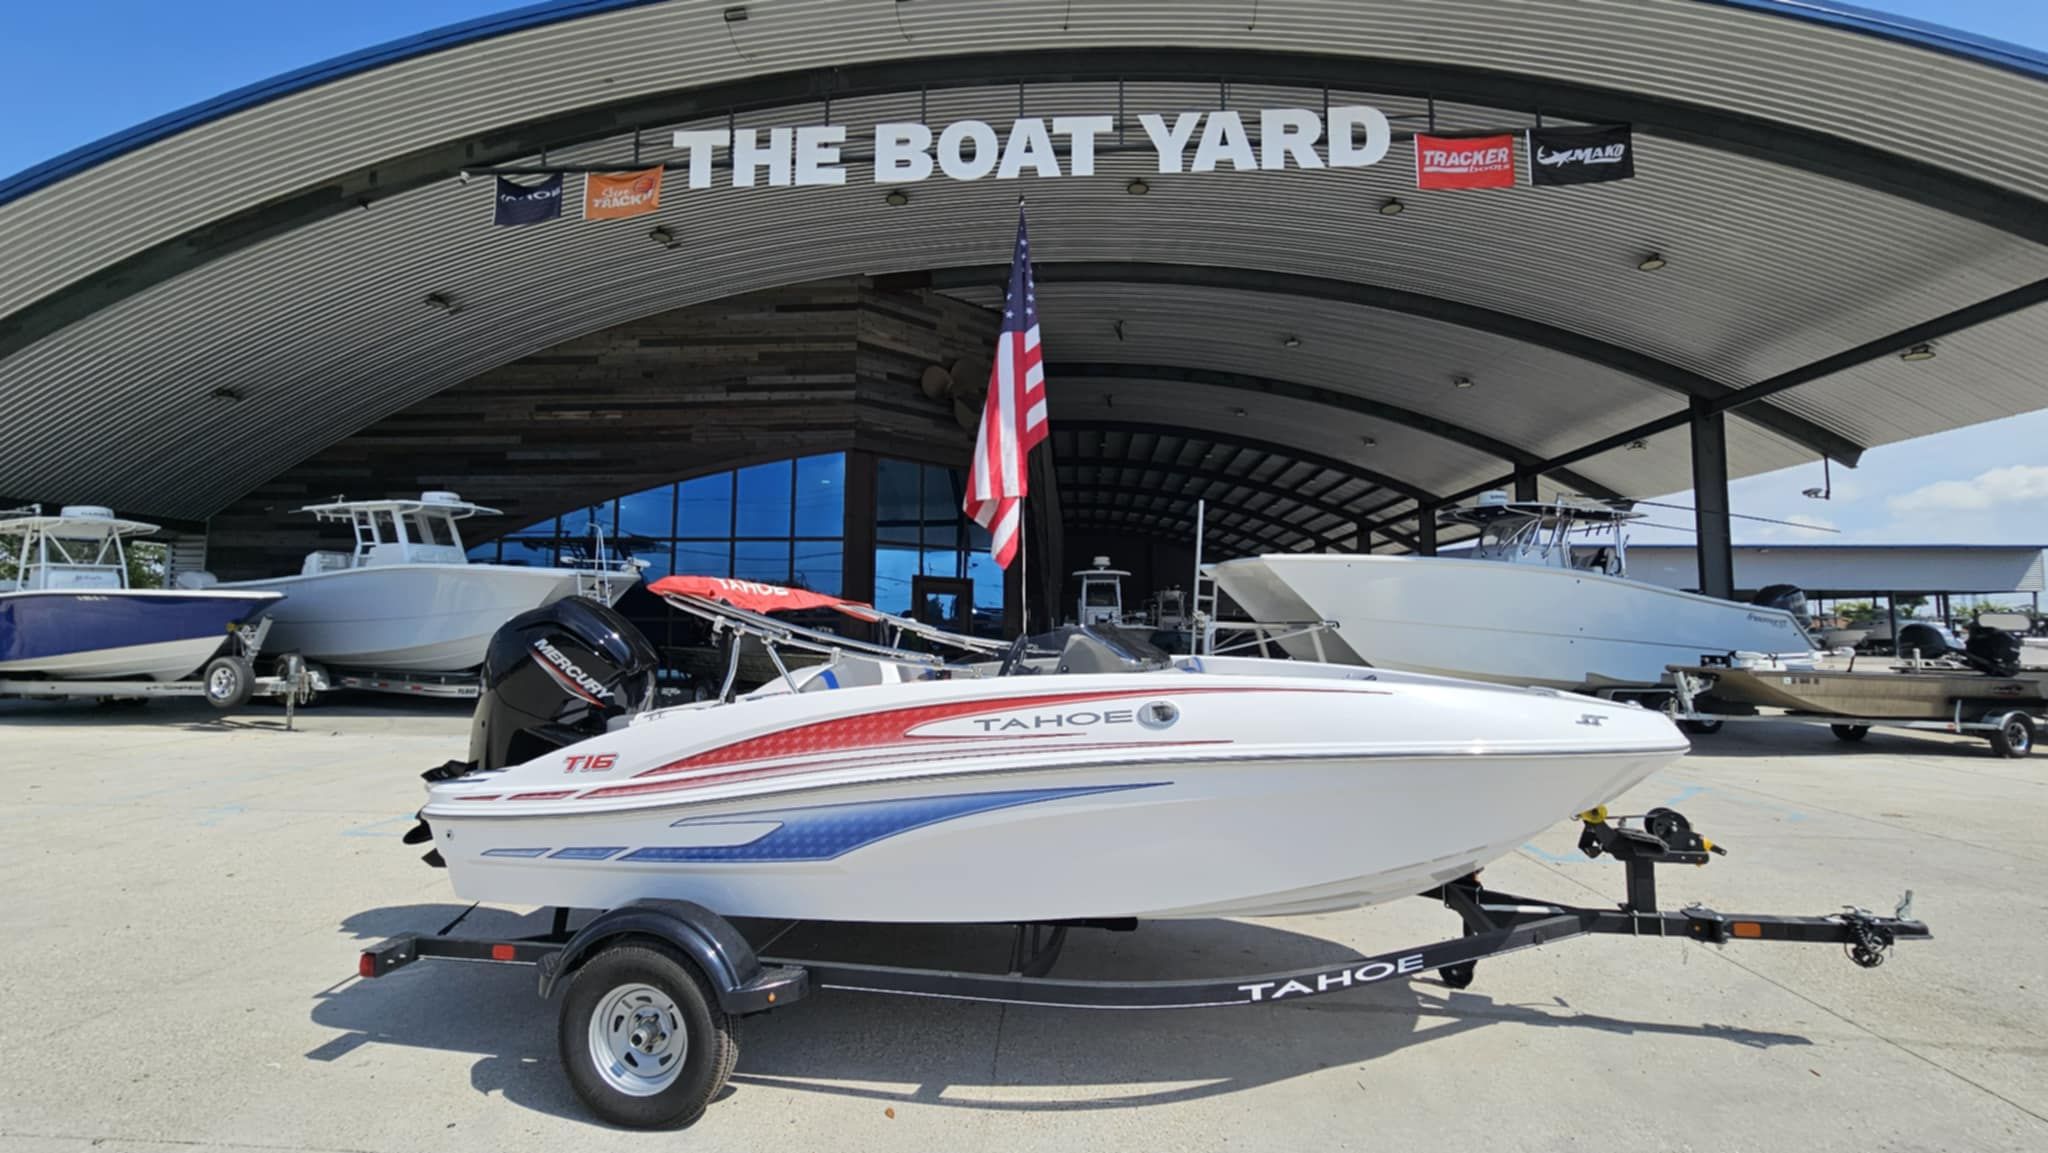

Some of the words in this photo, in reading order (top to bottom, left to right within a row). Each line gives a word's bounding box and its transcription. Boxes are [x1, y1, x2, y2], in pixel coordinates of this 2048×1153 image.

[673, 125, 847, 190] THE
[874, 115, 1114, 182] BOAT
[1137, 105, 1392, 174] YARD
[1422, 146, 1510, 168] TRACKER
[1568, 143, 1626, 164] MAKO
[533, 637, 615, 698] MERCURY
[973, 709, 1134, 732] TAHOE
[563, 753, 619, 774] T16
[1237, 953, 1424, 1001] TAHOE
